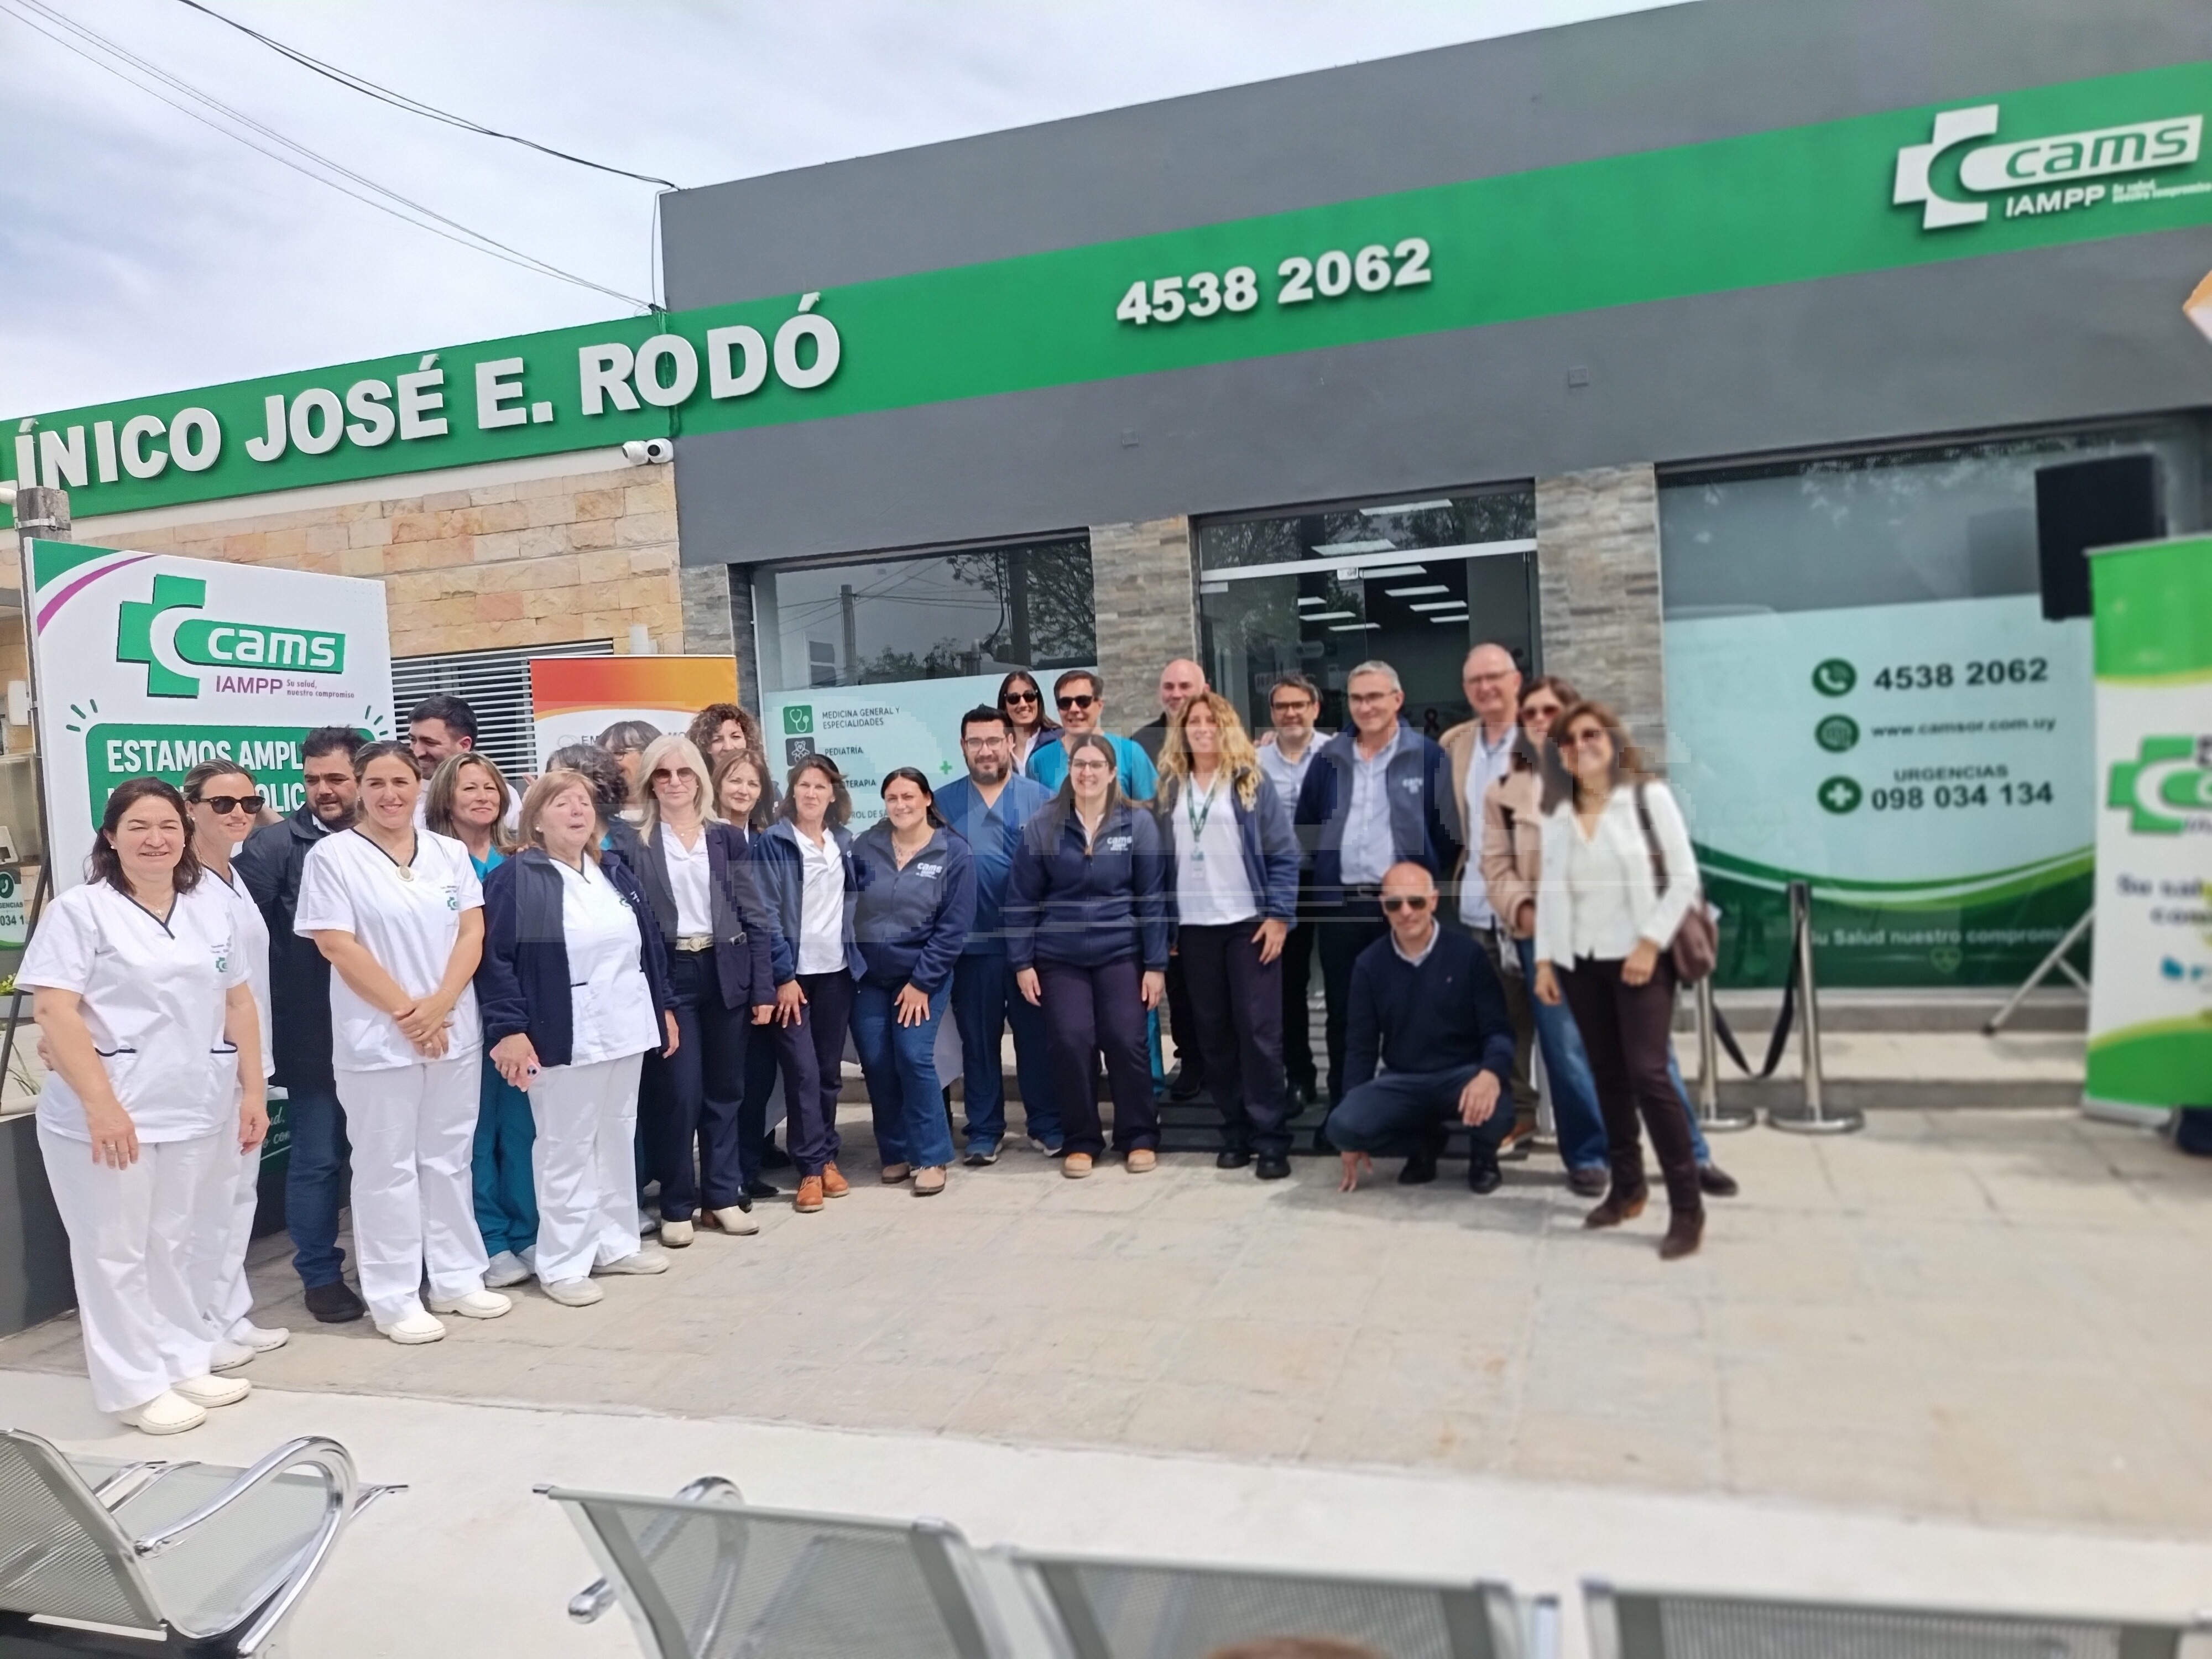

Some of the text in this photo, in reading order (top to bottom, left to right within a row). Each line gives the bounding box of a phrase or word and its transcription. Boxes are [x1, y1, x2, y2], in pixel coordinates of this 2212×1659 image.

[2005, 124, 2190, 180] cams
[2005, 184, 2106, 218] IAMPP
[1116, 237, 1432, 325] 4538 2062
[0, 291, 841, 491] ÍNICO JOSÉ E. RODÓ
[208, 627, 336, 667] cams
[1874, 657, 2049, 691] 4538 2062
[216, 675, 283, 695] IAMPP
[296, 679, 317, 689] salud,
[315, 690, 355, 699] compromiso
[822, 709, 858, 719] MEDICINA
[859, 707, 894, 717] GENERAL
[823, 717, 884, 729] ESPECIALIDADES
[107, 739, 304, 773] ESTAMOS AMPL
[825, 745, 864, 757] PEDIATRÍA
[1893, 764, 2009, 782] URGENCIAS
[845, 779, 877, 788] TERAPIA
[1871, 780, 2053, 811] 098 034 134
[868, 810, 877, 818] DE
[0, 915, 17, 926] 034
[1890, 929, 1961, 945] nuestro
